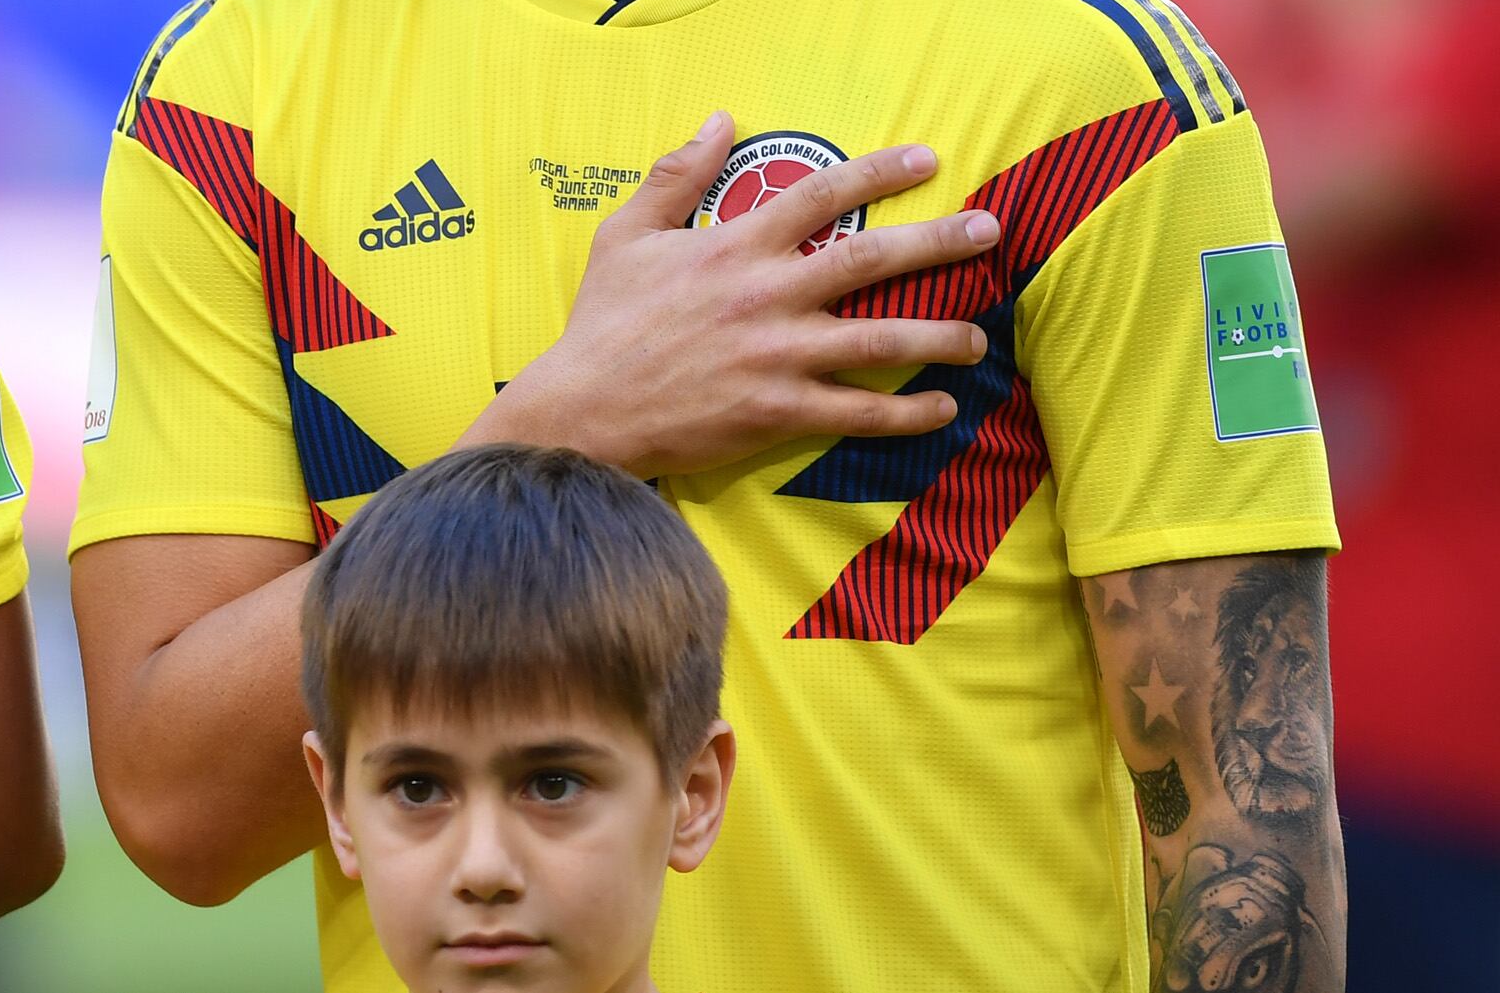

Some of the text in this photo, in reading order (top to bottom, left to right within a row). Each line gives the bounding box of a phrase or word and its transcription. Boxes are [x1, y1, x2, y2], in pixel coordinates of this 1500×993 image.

[541, 174, 618, 199] 28 JUNE 2018
[583, 166, 641, 184] COLOMBIA
[701, 142, 833, 212] FEDERACION COLOMBIAN
[359, 209, 475, 251] adidas
[1216, 302, 1296, 325] LIVI
[85, 409, 107, 430] 018
